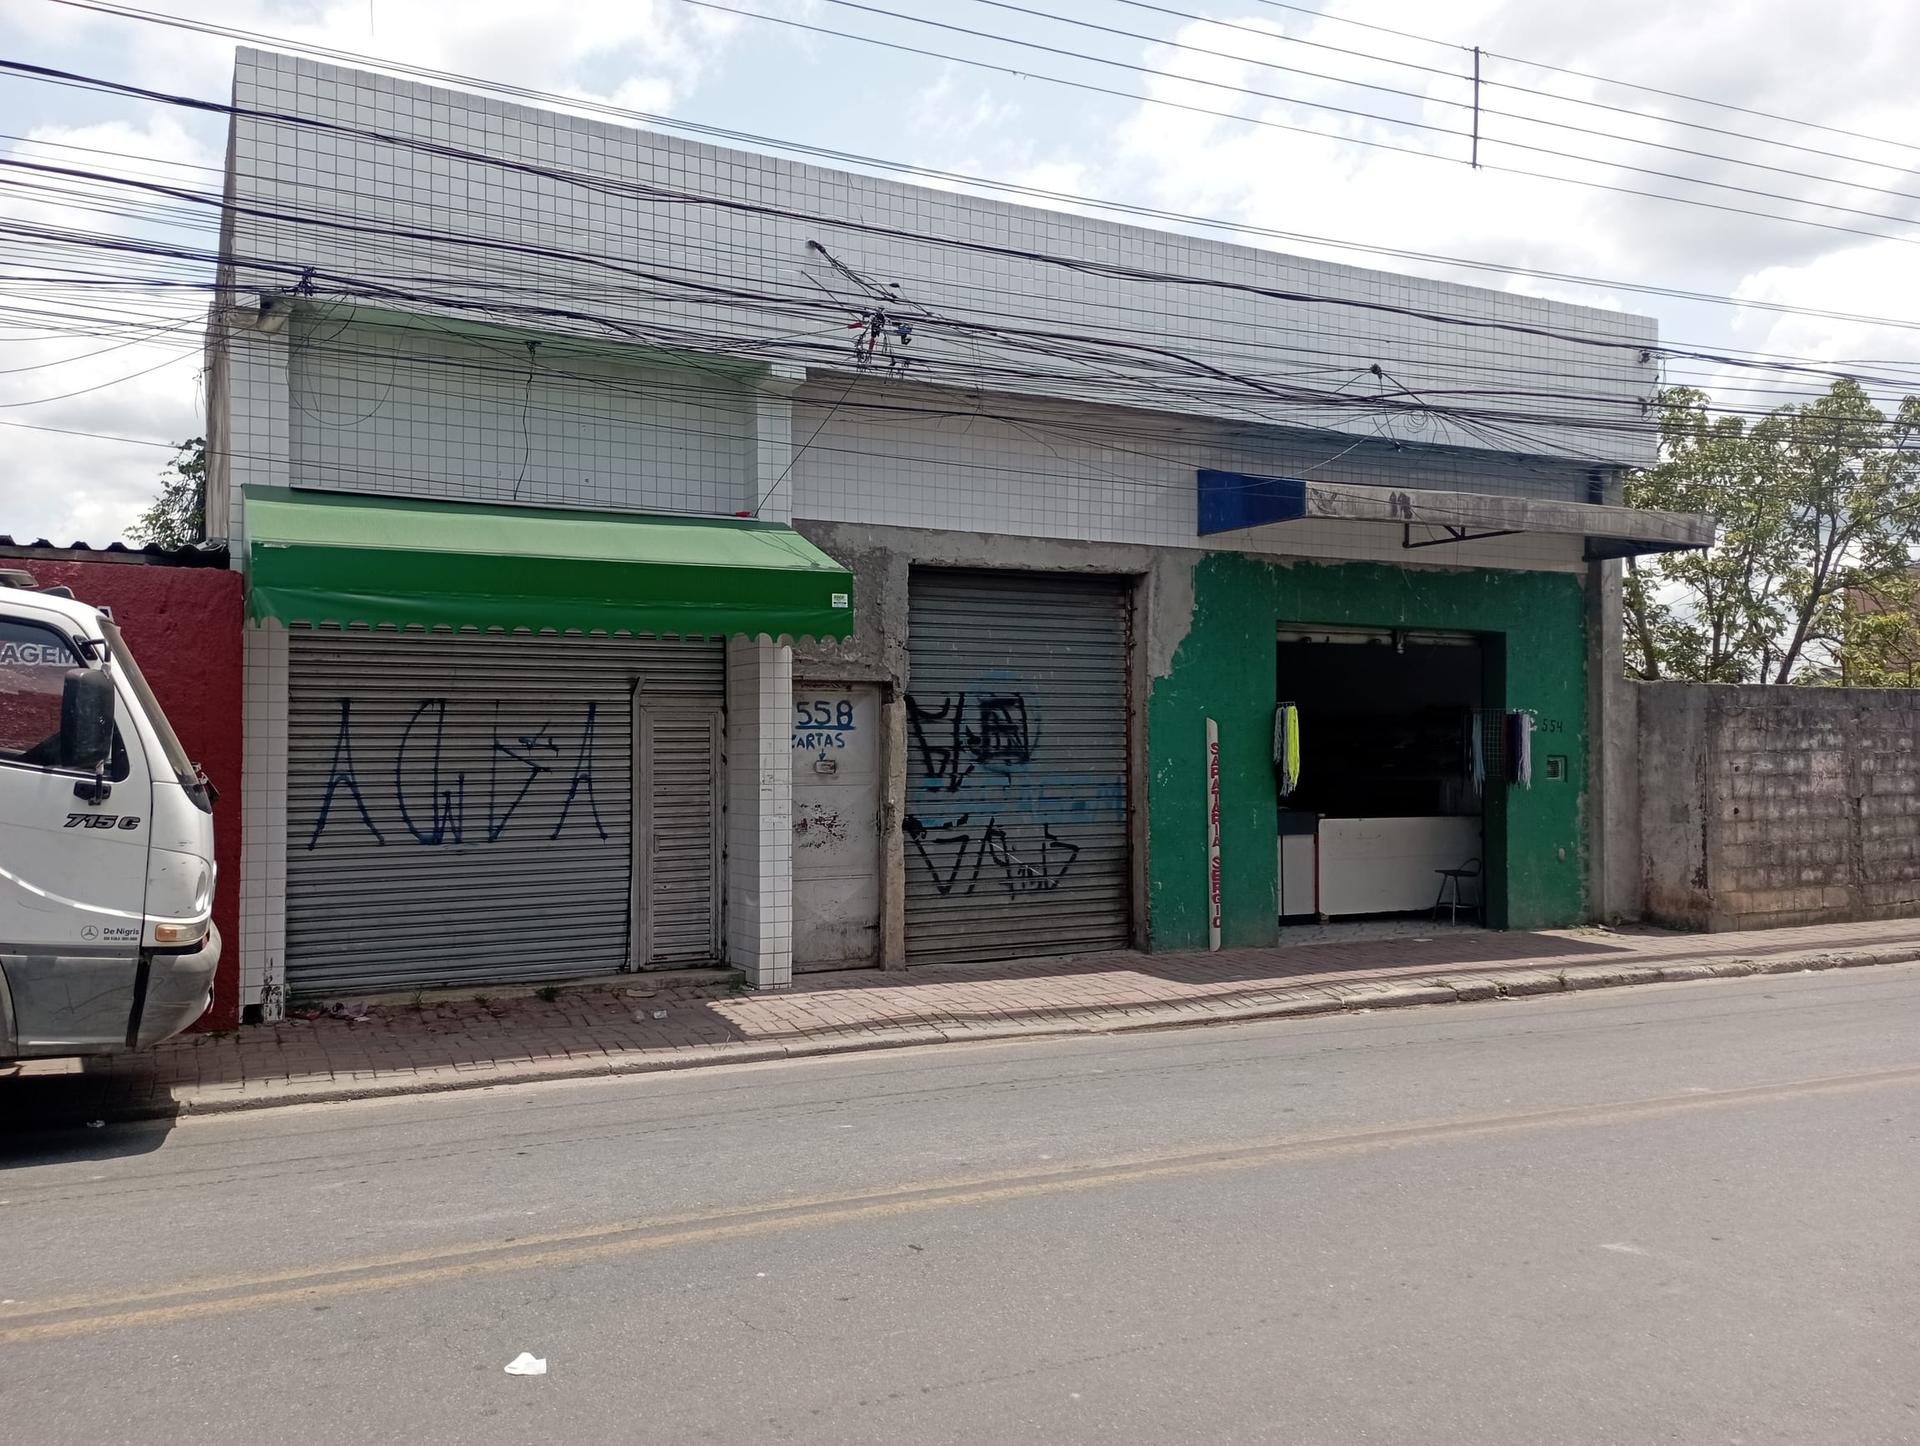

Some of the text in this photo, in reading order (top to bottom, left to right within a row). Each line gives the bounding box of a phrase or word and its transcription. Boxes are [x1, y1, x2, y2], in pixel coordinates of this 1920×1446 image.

[796, 700, 853, 726] 558
[1541, 718, 1563, 733] 554
[1210, 741, 1221, 848] SAPATARIA
